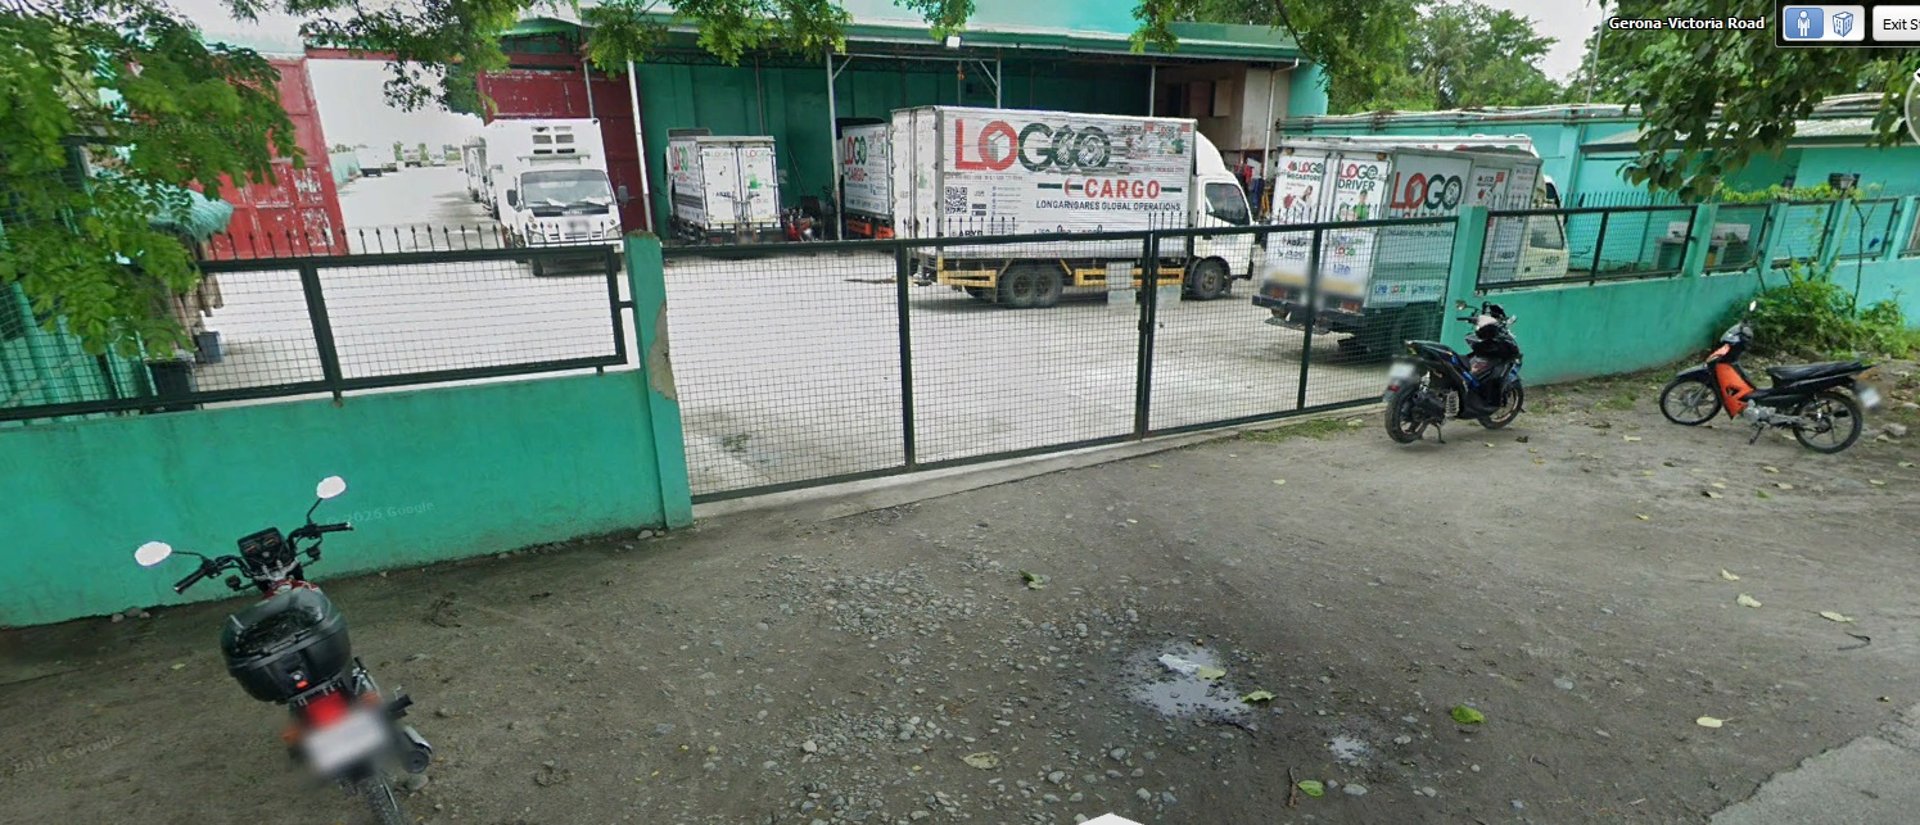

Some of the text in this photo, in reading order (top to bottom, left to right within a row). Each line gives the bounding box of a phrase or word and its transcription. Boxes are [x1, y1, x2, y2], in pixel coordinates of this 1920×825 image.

[1340, 161, 1379, 180] LOGO
[1084, 178, 1161, 200] CARGO
[1337, 179, 1376, 192] DRIVER
[1389, 171, 1463, 211] LOGO
[1101, 201, 1131, 211] GLOBAL
[1133, 202, 1181, 212] OPERATIONS
